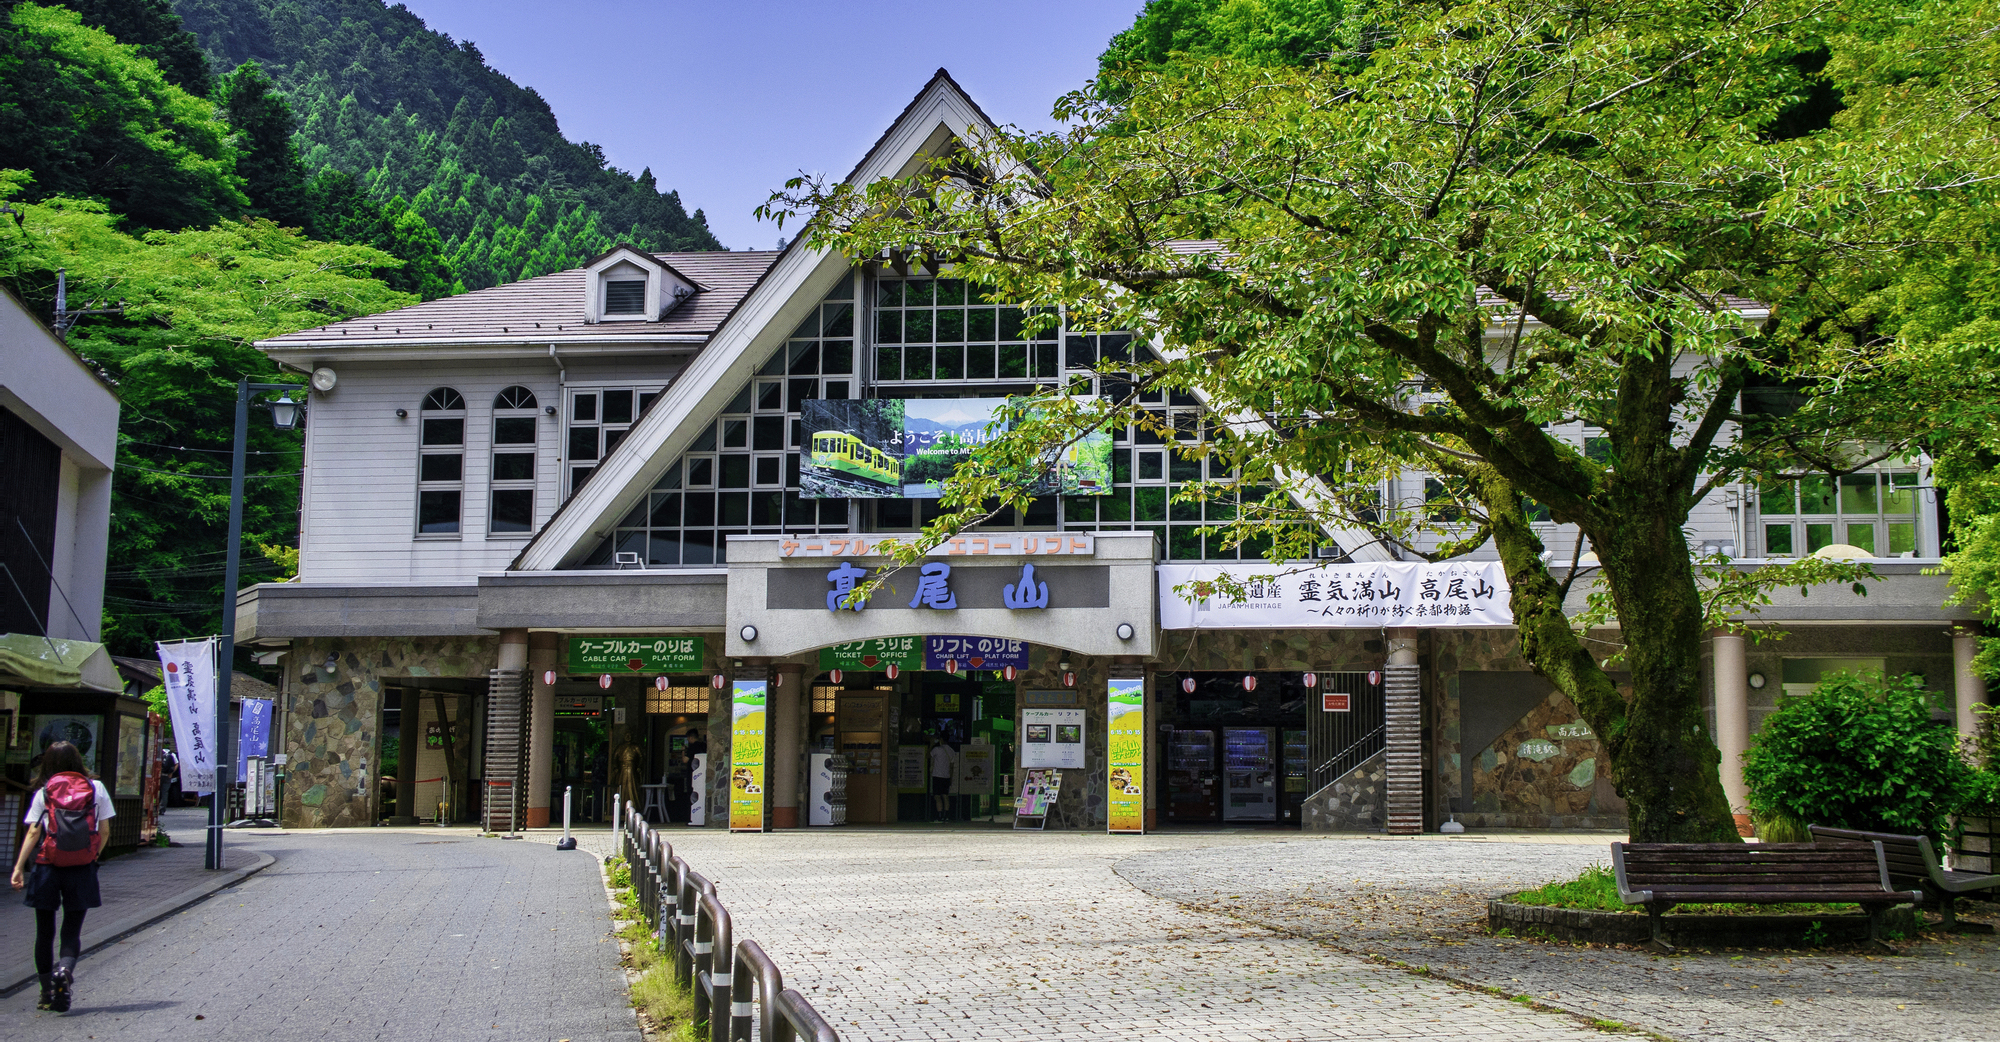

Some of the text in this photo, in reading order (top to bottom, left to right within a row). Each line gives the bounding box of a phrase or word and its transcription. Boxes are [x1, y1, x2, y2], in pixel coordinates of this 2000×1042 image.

[782, 540, 916, 556] ケーブル
[1024, 537, 1086, 554] リフト
[1298, 579, 1401, 602] 霊気満山
[1419, 578, 1495, 601] 高尾山
[579, 639, 694, 654] ケーブルカーのりば
[932, 638, 1022, 653] リフト のりば
[1558, 726, 1592, 737] 高尾山
[1523, 743, 1554, 755] 清滝駅
